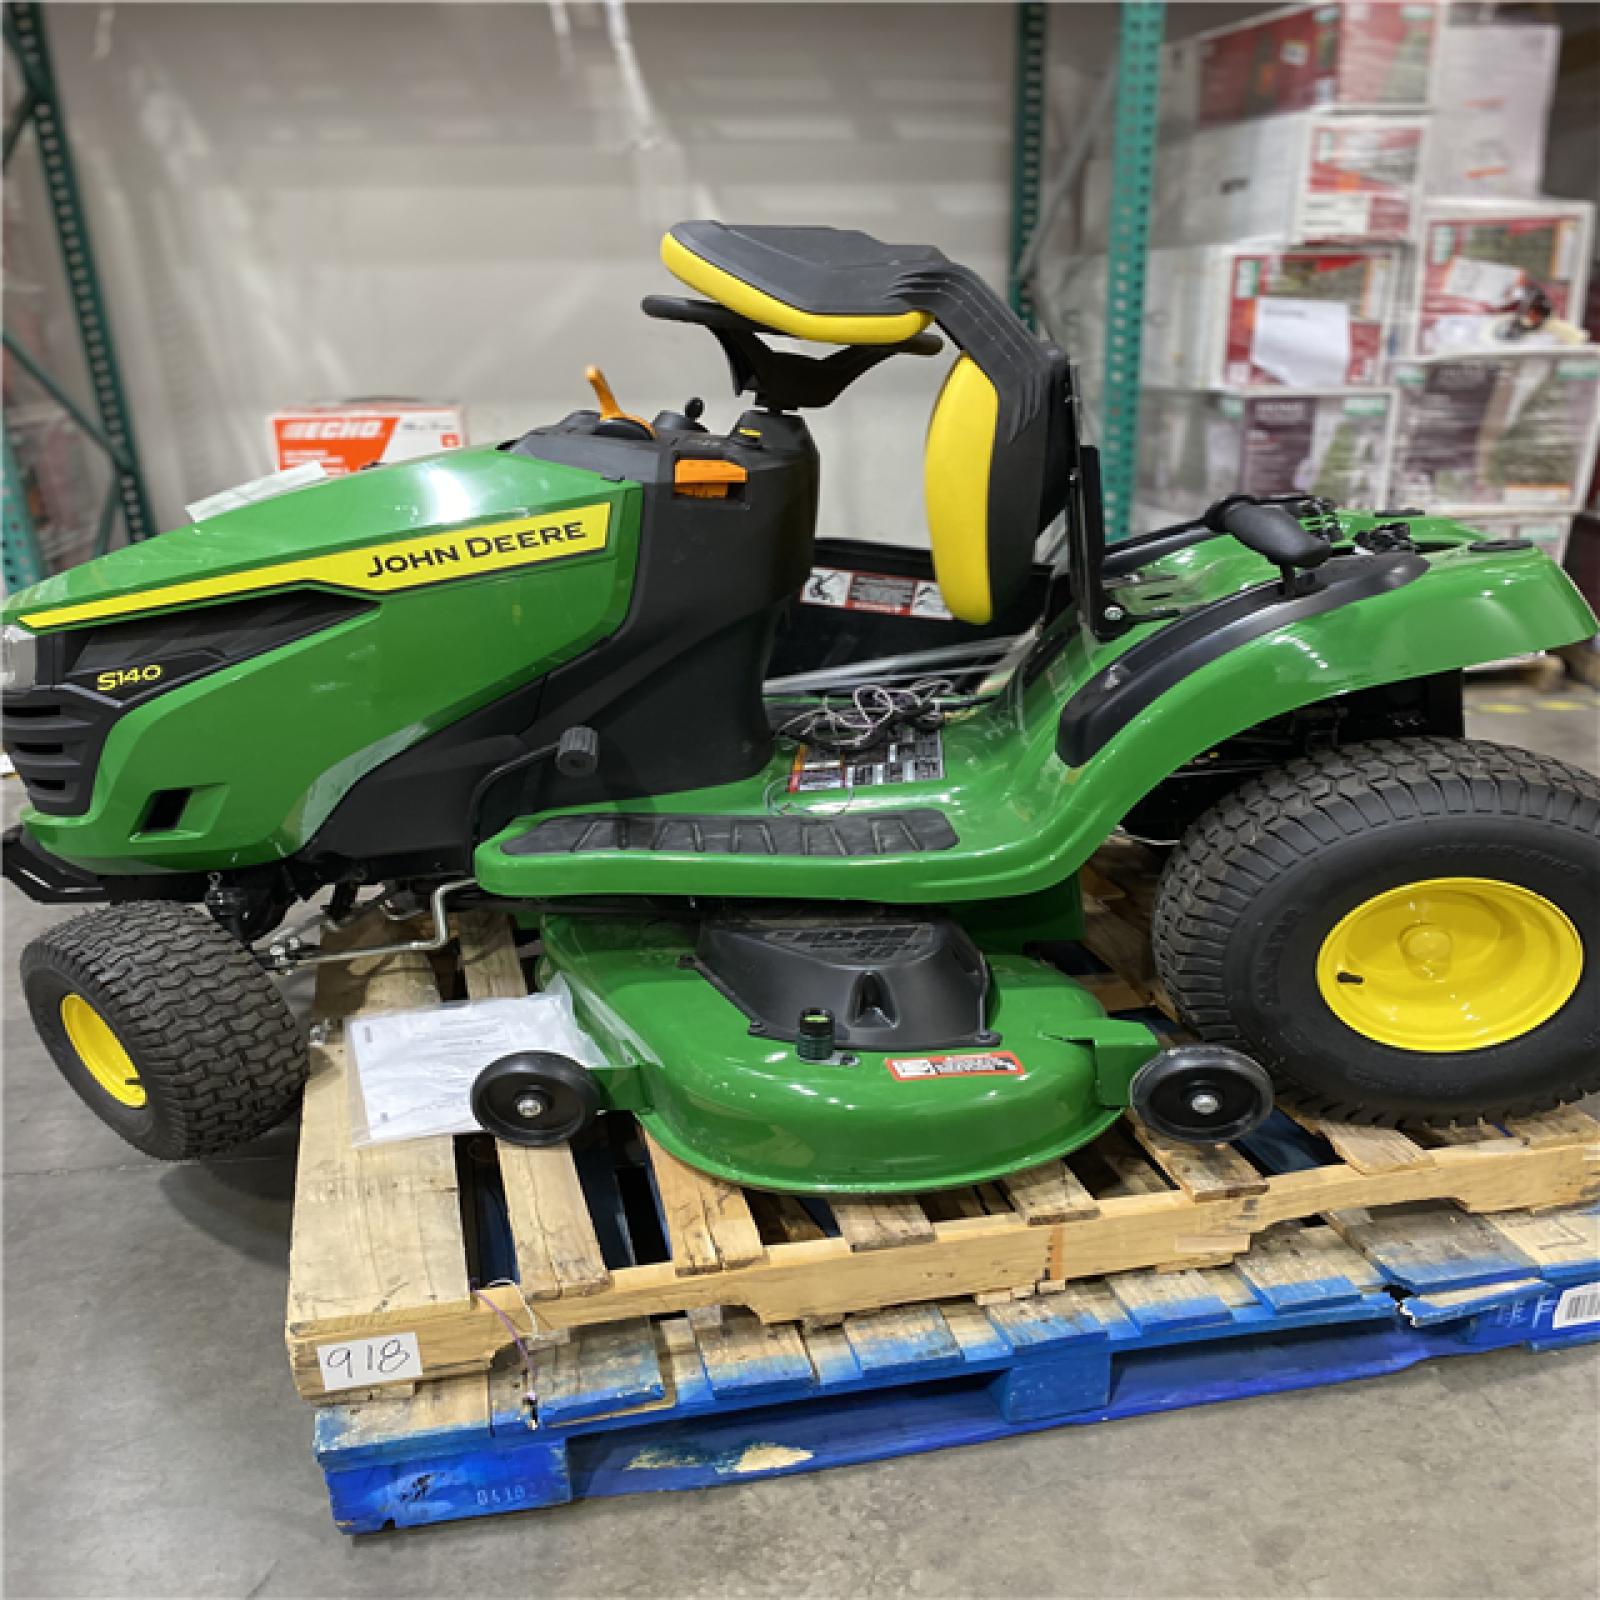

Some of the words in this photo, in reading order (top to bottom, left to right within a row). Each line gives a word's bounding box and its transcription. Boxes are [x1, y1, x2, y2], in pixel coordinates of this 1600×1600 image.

[367, 545, 461, 578] JOHN
[464, 521, 588, 559] DEERE
[96, 664, 162, 691] S140
[326, 1338, 411, 1378] 918
